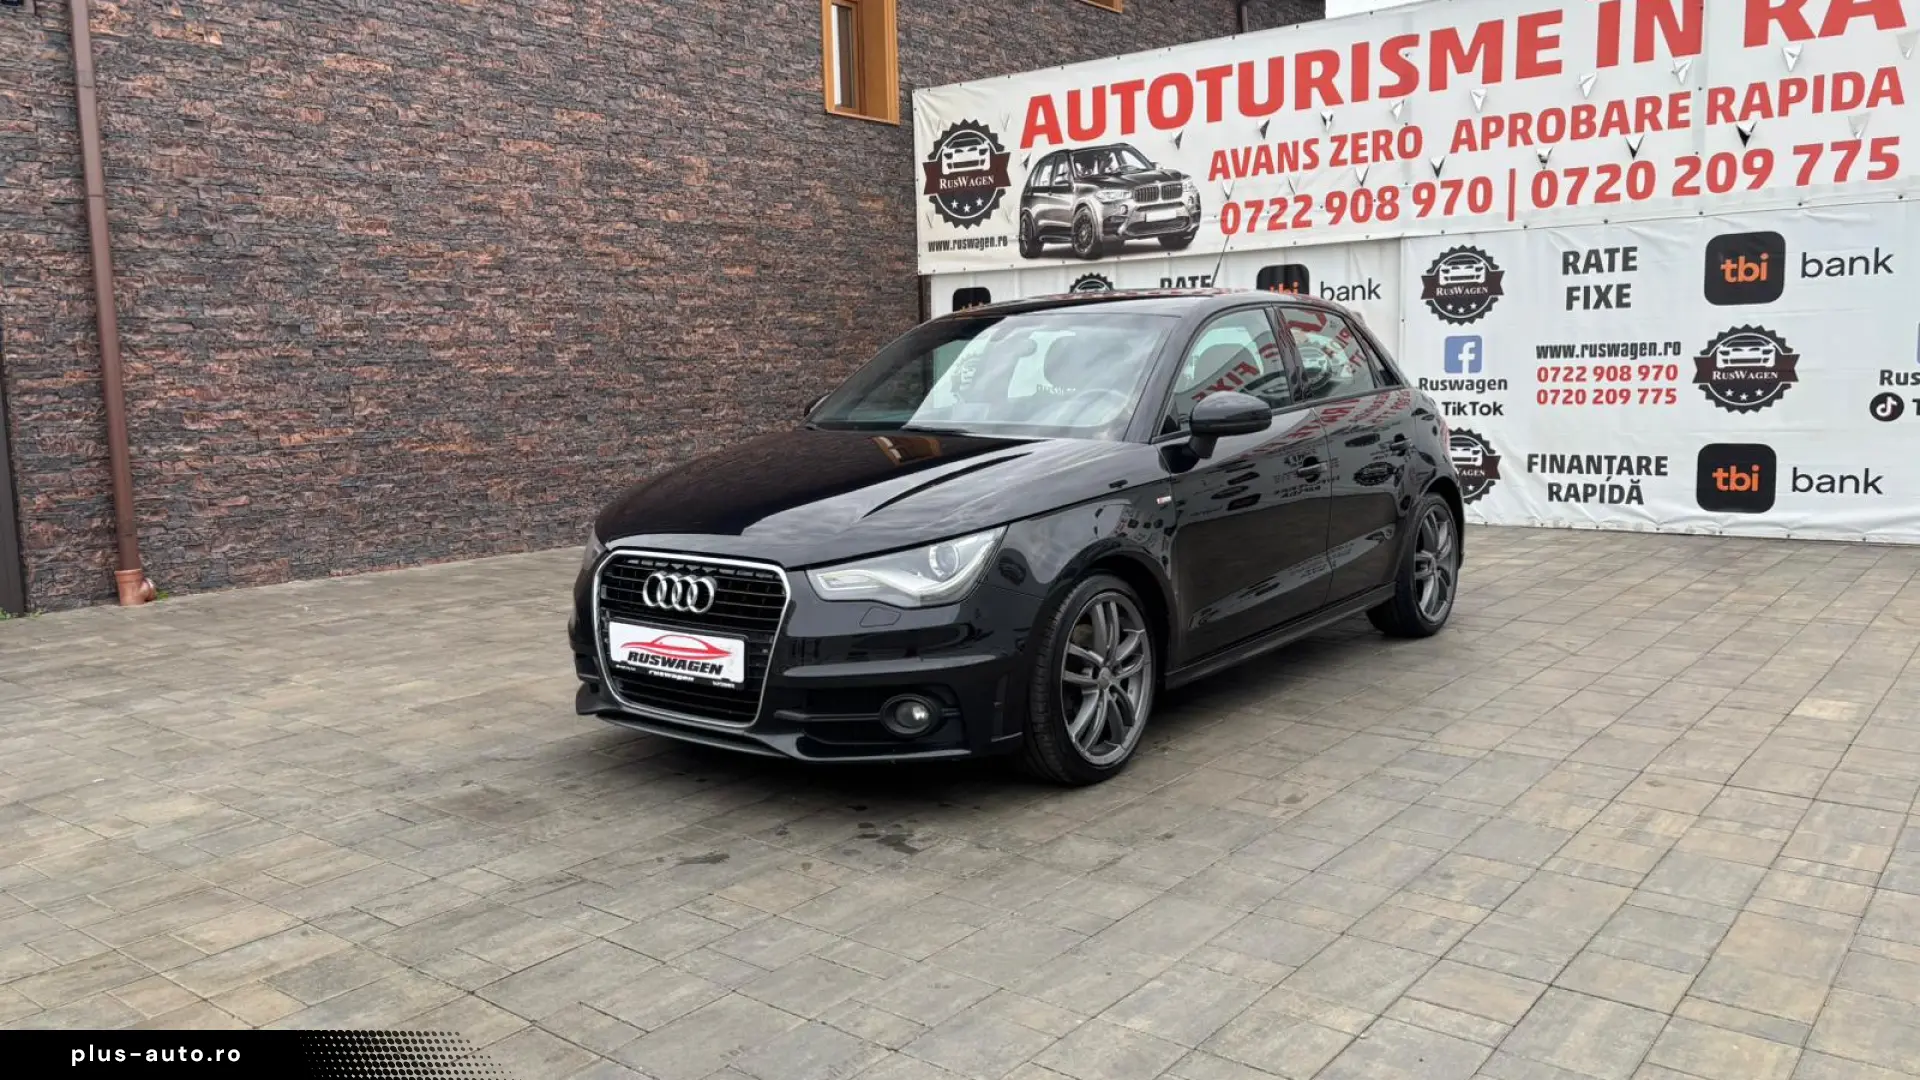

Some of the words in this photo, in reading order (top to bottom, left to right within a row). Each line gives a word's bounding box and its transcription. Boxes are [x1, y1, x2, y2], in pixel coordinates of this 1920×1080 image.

[1020, 9, 1564, 149] AUTOTURISME
[1596, 0, 1703, 68] IN
[1208, 137, 1320, 182] AVANS
[1330, 125, 1423, 167] ZERO
[1449, 91, 1692, 154] APROBARE
[1705, 66, 1905, 125] RAPIDA
[1220, 193, 1312, 235] 0722
[1325, 185, 1400, 226] 908
[1411, 175, 1494, 218] 970
[1531, 160, 1657, 210] 0720
[1671, 148, 1775, 197] 209
[1793, 136, 1900, 186] 775
[928, 235, 1008, 252] www.ruswagen.ro
[1561, 246, 1638, 276] RATE
[1720, 252, 1769, 283] tbi
[1800, 247, 1894, 279] bank
[1320, 278, 1381, 301] bank
[1565, 283, 1632, 311] FIXE
[1535, 341, 1681, 361] www.ruswagen.ro
[1418, 376, 1508, 394] Ruswagen
[1536, 366, 1587, 383] 0722
[1592, 365, 1633, 382] 908
[1637, 364, 1679, 382] 970
[1441, 401, 1504, 416] TikTok
[1536, 389, 1587, 406] 0720
[1592, 388, 1633, 405] 209
[1637, 388, 1677, 405] 775
[1712, 464, 1760, 493] tbi
[1791, 467, 1884, 496] bank
[627, 650, 723, 676] RUSWAGEN
